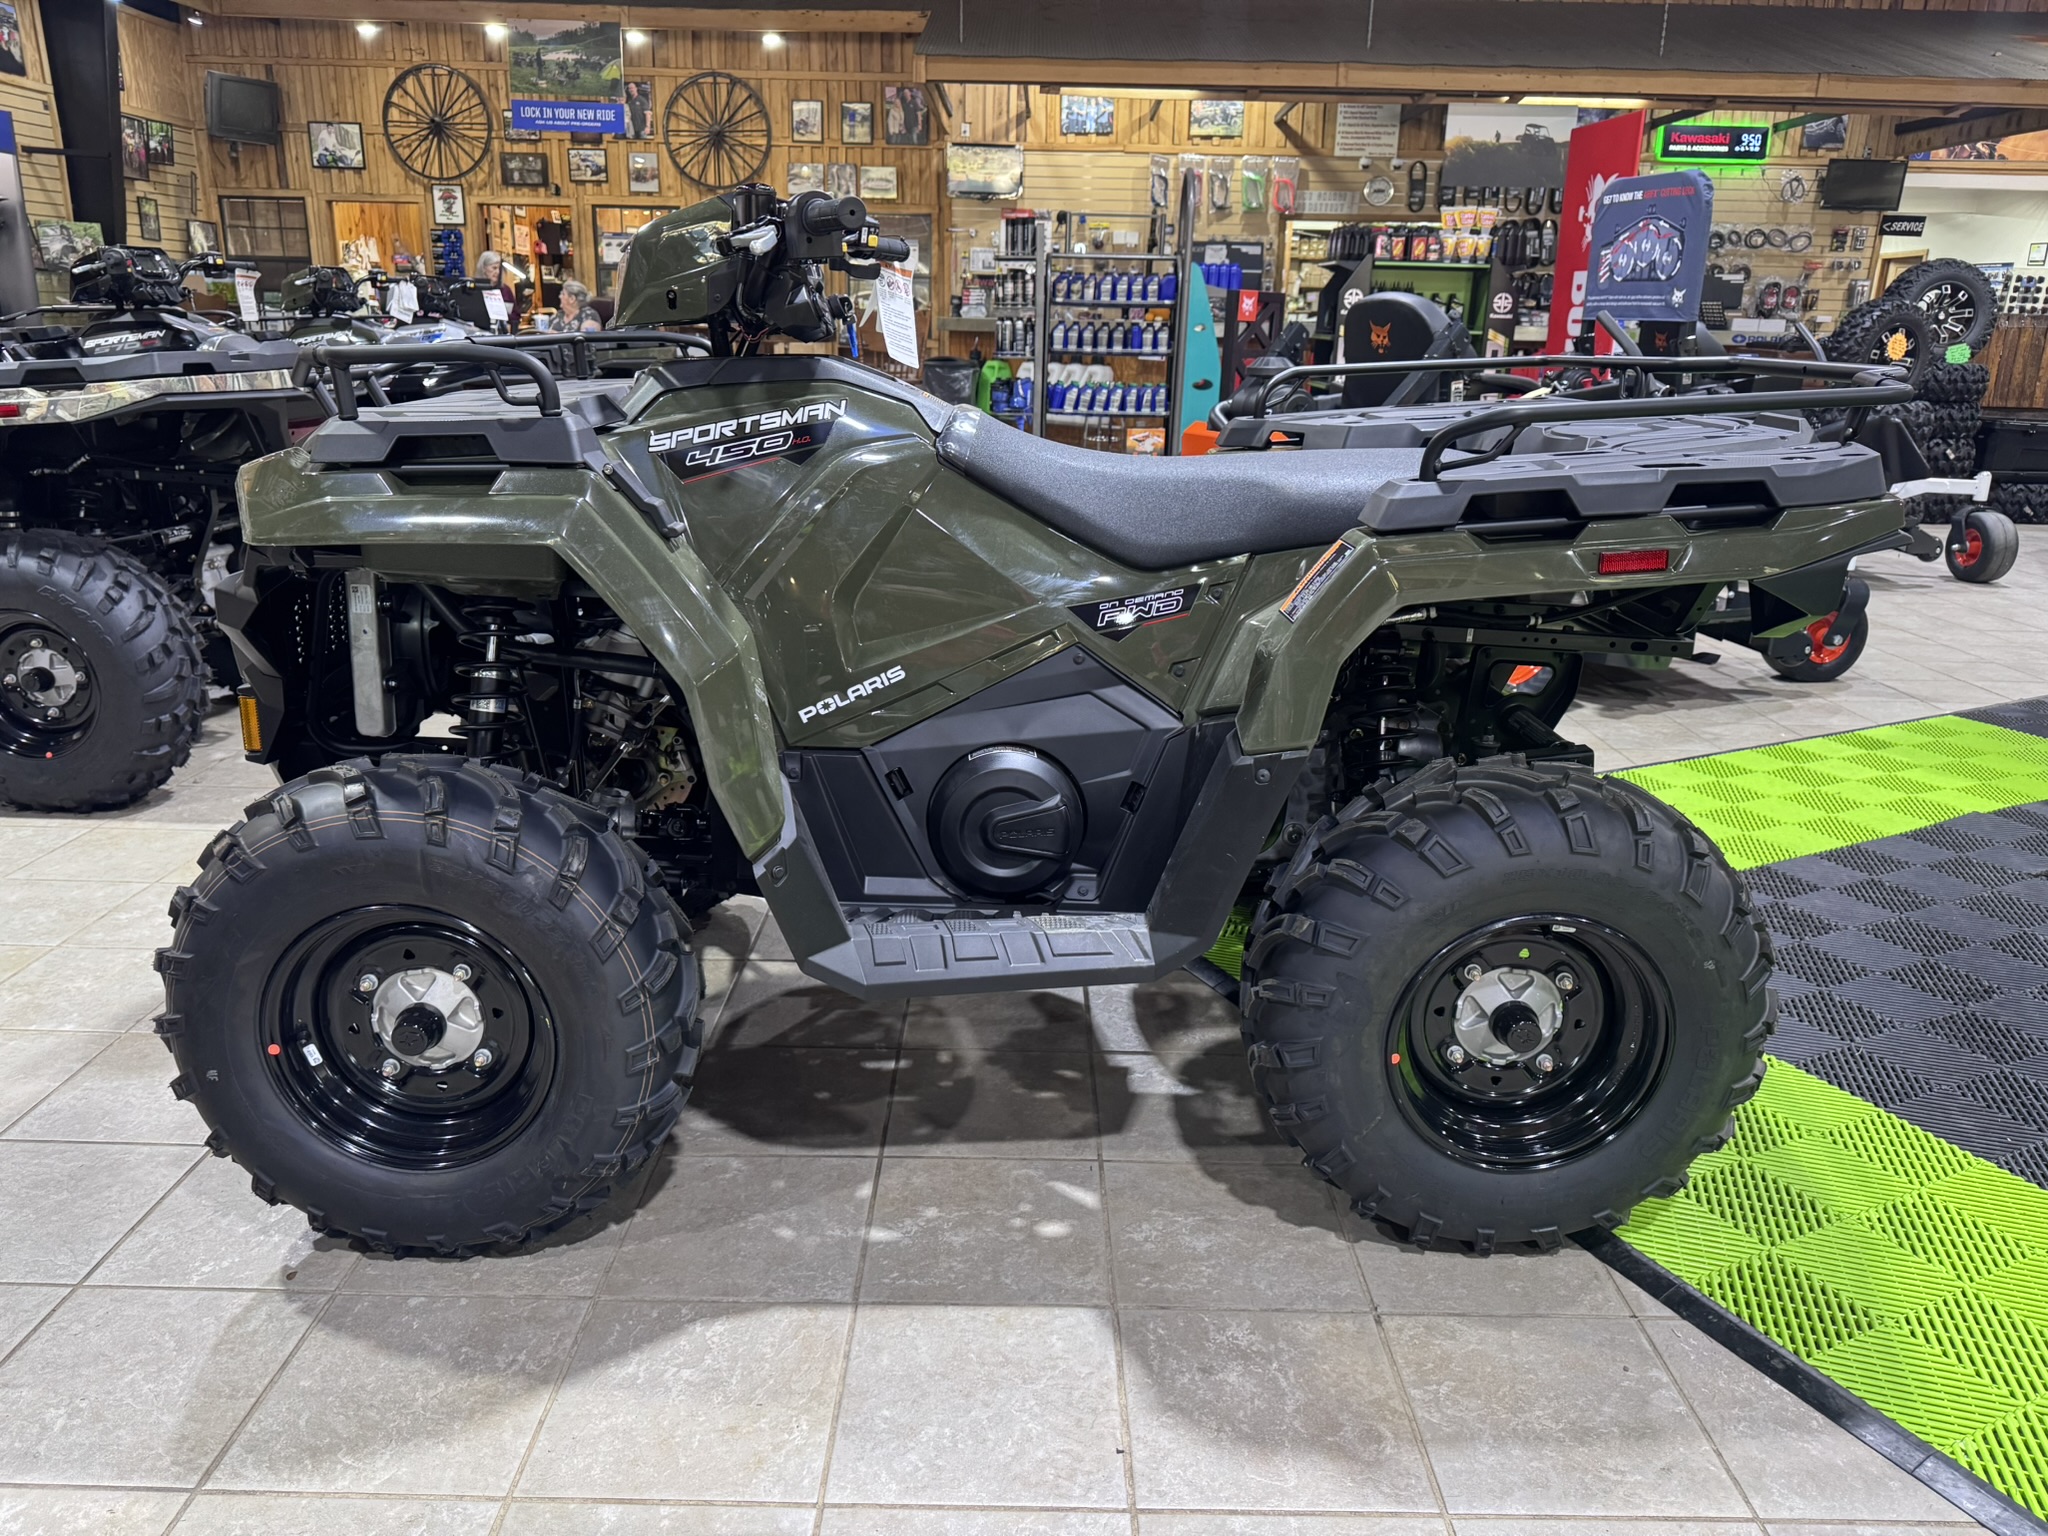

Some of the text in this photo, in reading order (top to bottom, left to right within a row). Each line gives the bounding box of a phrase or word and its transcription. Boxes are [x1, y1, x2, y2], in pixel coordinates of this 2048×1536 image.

[520, 106, 616, 121] LOCK IN YOUR NEW RIDE
[1671, 132, 1731, 144] Kawasaki
[1603, 192, 1613, 204] GET
[1612, 192, 1620, 203] TO
[1619, 191, 1634, 203] KNOW
[1634, 190, 1643, 201] THE
[1890, 221, 1924, 232] SERVICE
[84, 328, 167, 350] SPORTSMAN
[94, 341, 141, 354] 570
[649, 399, 847, 452] SPORTSMAN
[686, 431, 812, 466] 450 H.O.
[1099, 588, 1185, 610] ON DEMAND
[1097, 596, 1183, 627] AWD
[798, 665, 906, 723] POLARIS
[998, 827, 1055, 841] POLARIS
